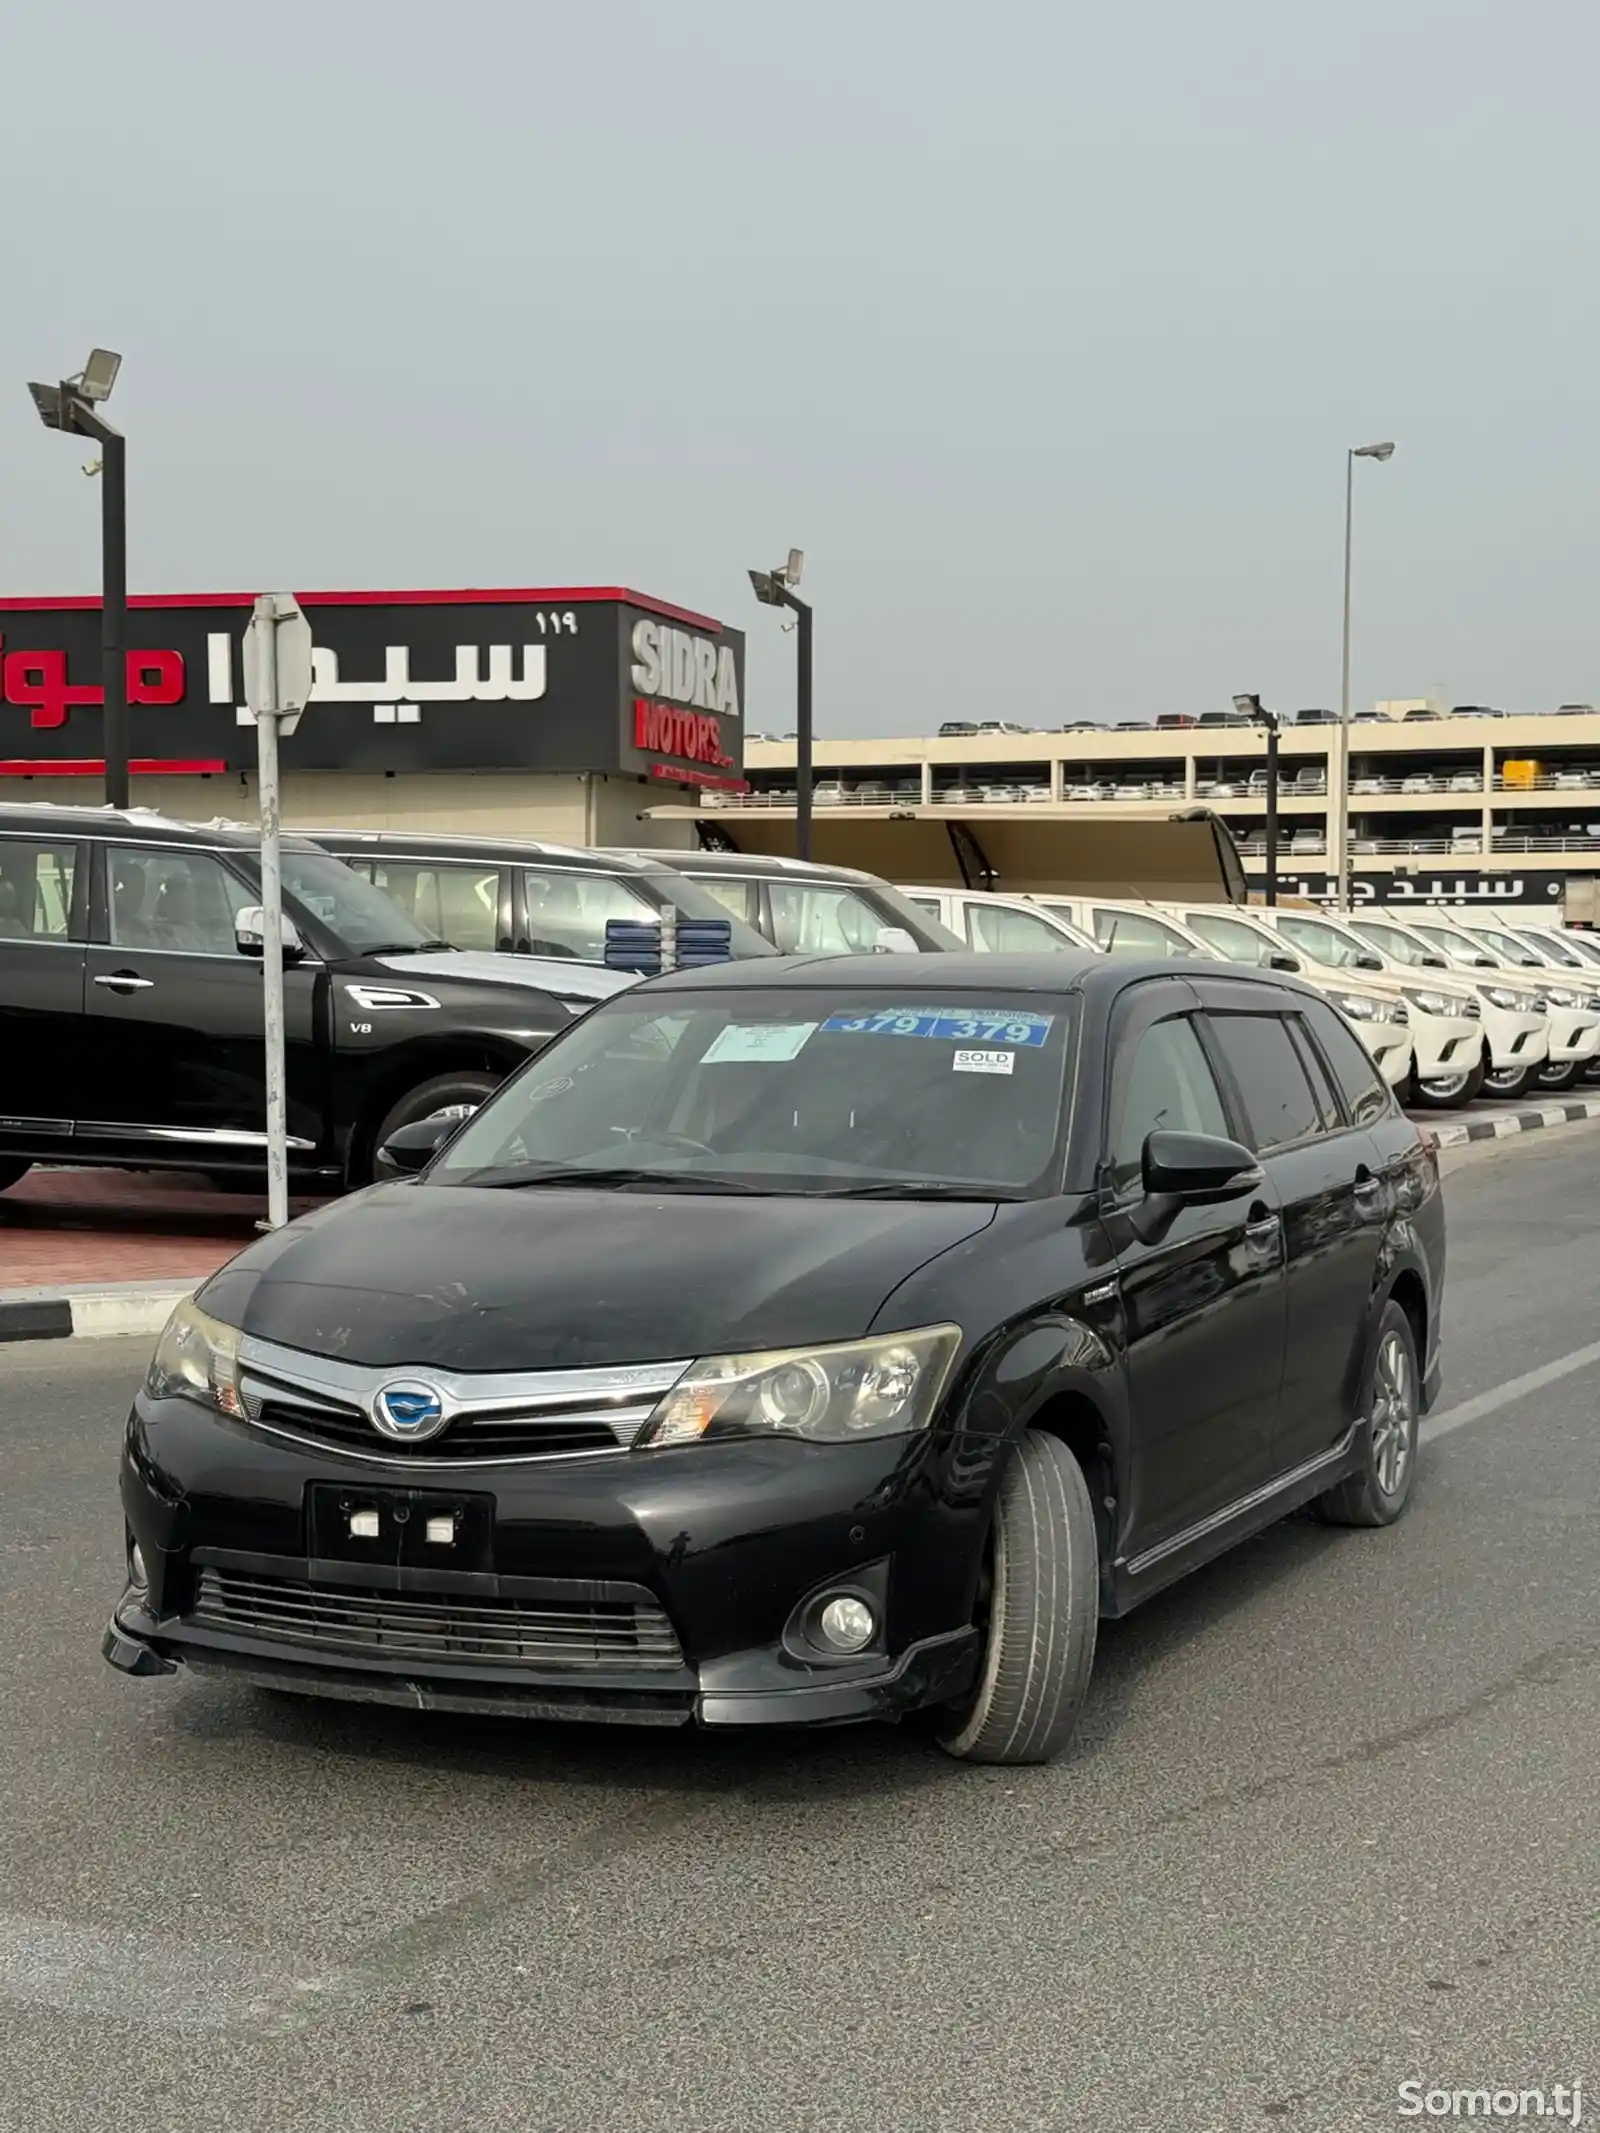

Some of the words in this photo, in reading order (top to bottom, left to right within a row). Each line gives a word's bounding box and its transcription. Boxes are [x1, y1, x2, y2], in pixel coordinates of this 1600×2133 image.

[630, 619, 740, 717] SIDRA
[634, 697, 722, 763] MOTORS
[350, 1022, 372, 1034] V8
[951, 1019, 1031, 1043] 379
[958, 1052, 1009, 1063] SOLD
